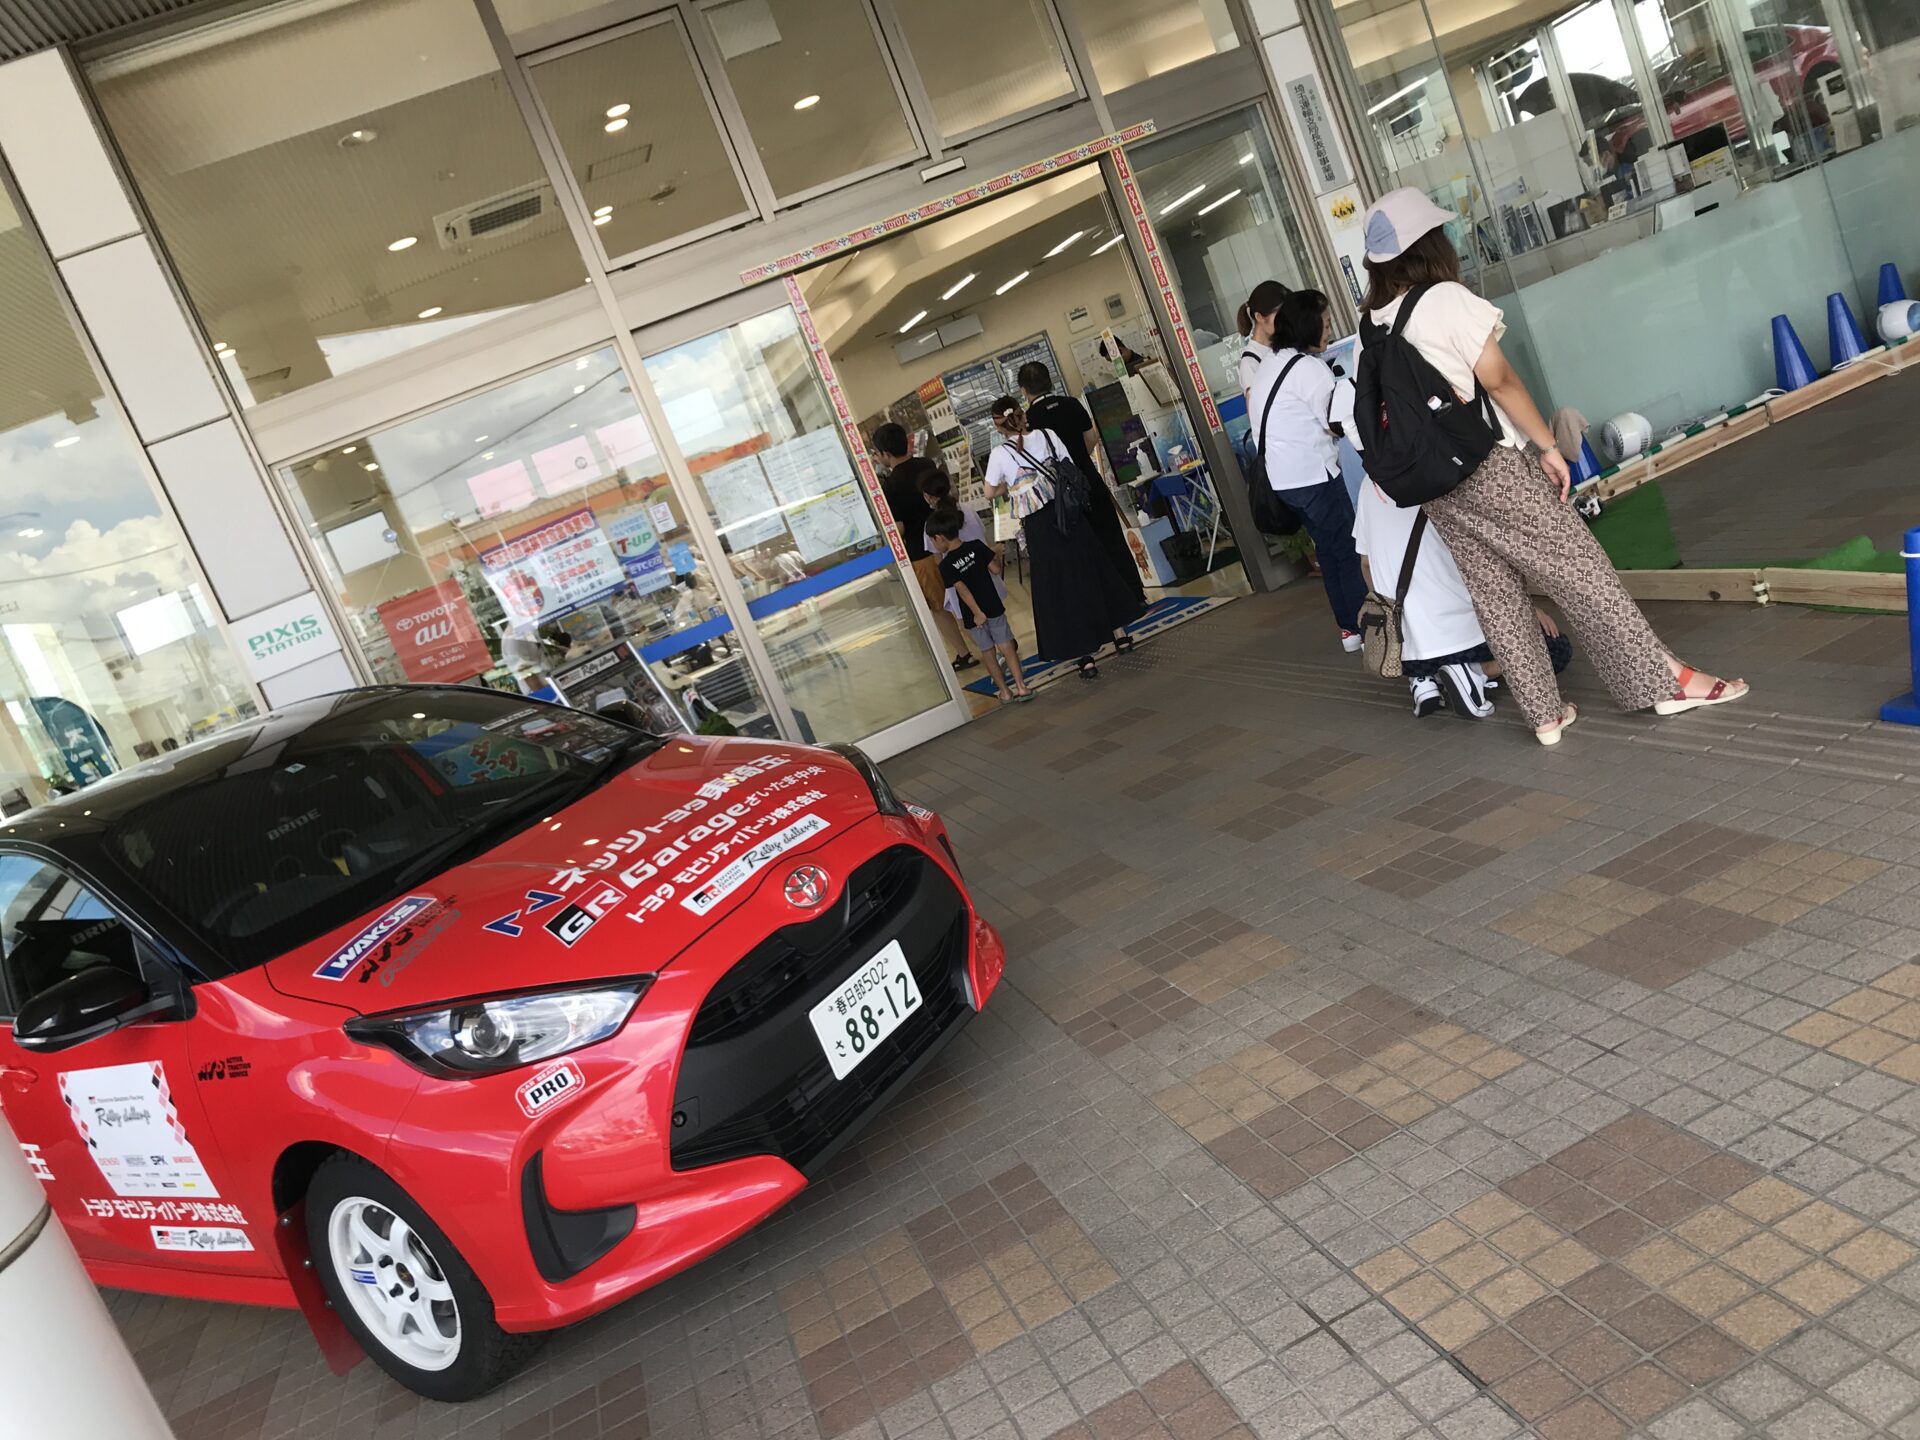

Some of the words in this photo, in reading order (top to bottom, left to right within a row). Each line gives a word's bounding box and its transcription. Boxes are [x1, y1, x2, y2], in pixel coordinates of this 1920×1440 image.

[884, 214, 909, 230] TOYOTA
[987, 175, 1012, 191] TOYOTA
[1022, 162, 1046, 179] WELCOME
[1088, 139, 1112, 154] TOYOTA
[1121, 126, 1145, 141] TOYOTA
[1113, 150, 1127, 177] TOYOTA
[1127, 185, 1141, 213] TOYOTA
[1166, 294, 1179, 320] TOYOTA
[1204, 400, 1217, 426] TOYOTA
[617, 532, 652, 554] T-UP
[412, 602, 458, 624] TOYOTA
[248, 614, 318, 651] PIXIS
[254, 627, 323, 661] STATION
[415, 620, 455, 646] au
[266, 808, 321, 841] BRIDE
[548, 754, 792, 891] ネッツトヨタ東埼玉
[556, 887, 625, 944] GR
[619, 802, 751, 889] Garage
[744, 765, 826, 807] さいたま中央
[625, 883, 676, 923] トヨタ
[672, 789, 828, 884] モビリティパーツ株式会社
[742, 841, 781, 869] Rally
[71, 917, 122, 947] BRID
[846, 972, 916, 1053] 88-12
[835, 1040, 847, 1057] さ
[530, 1072, 569, 1104] PRO
[80, 1198, 115, 1217] トヨタ
